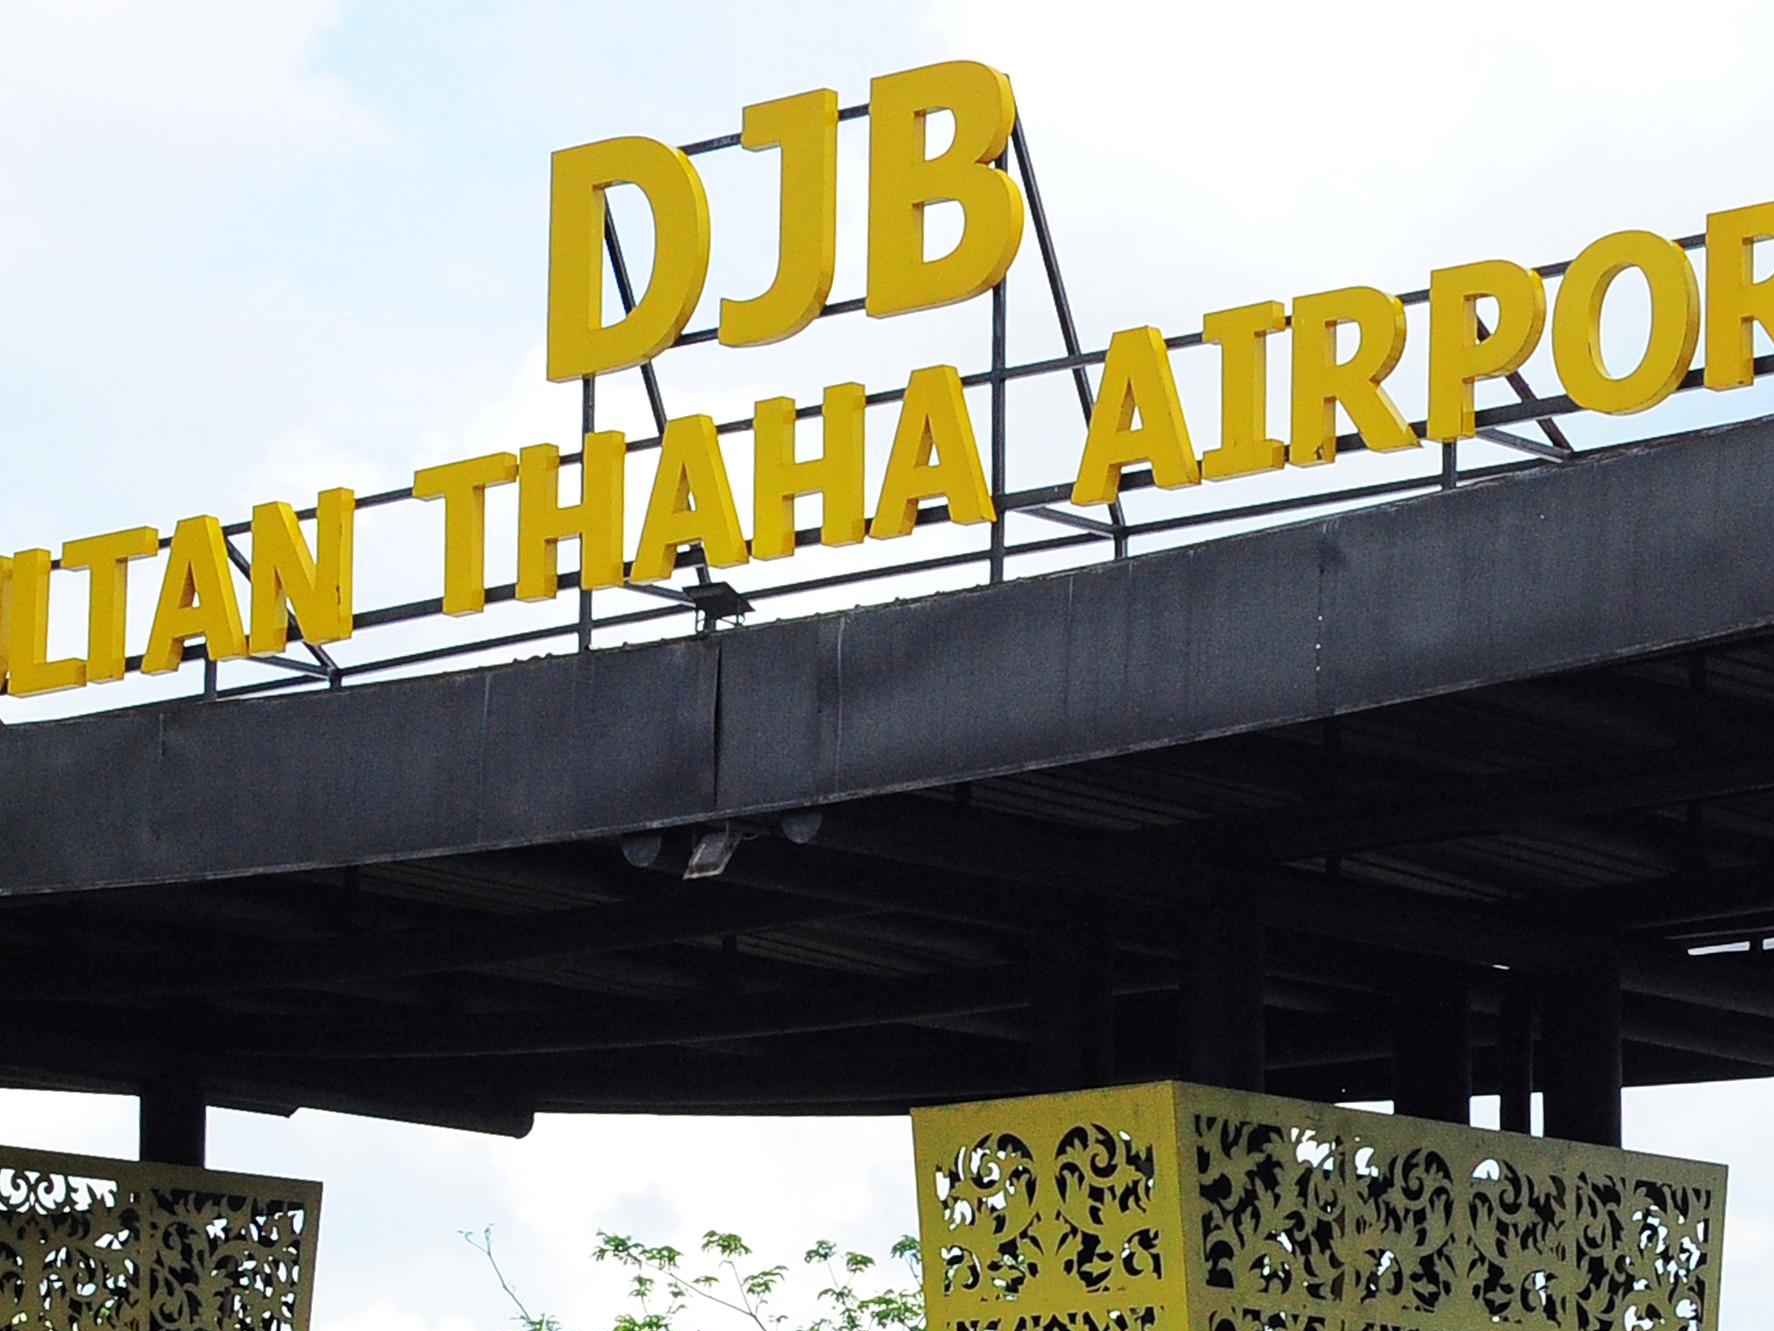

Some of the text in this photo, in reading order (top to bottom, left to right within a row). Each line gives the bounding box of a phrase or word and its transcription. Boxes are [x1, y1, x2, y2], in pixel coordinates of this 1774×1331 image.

[546, 60, 1024, 383] DJB
[0, 488, 354, 698] LTAN
[413, 365, 997, 616] THAHA
